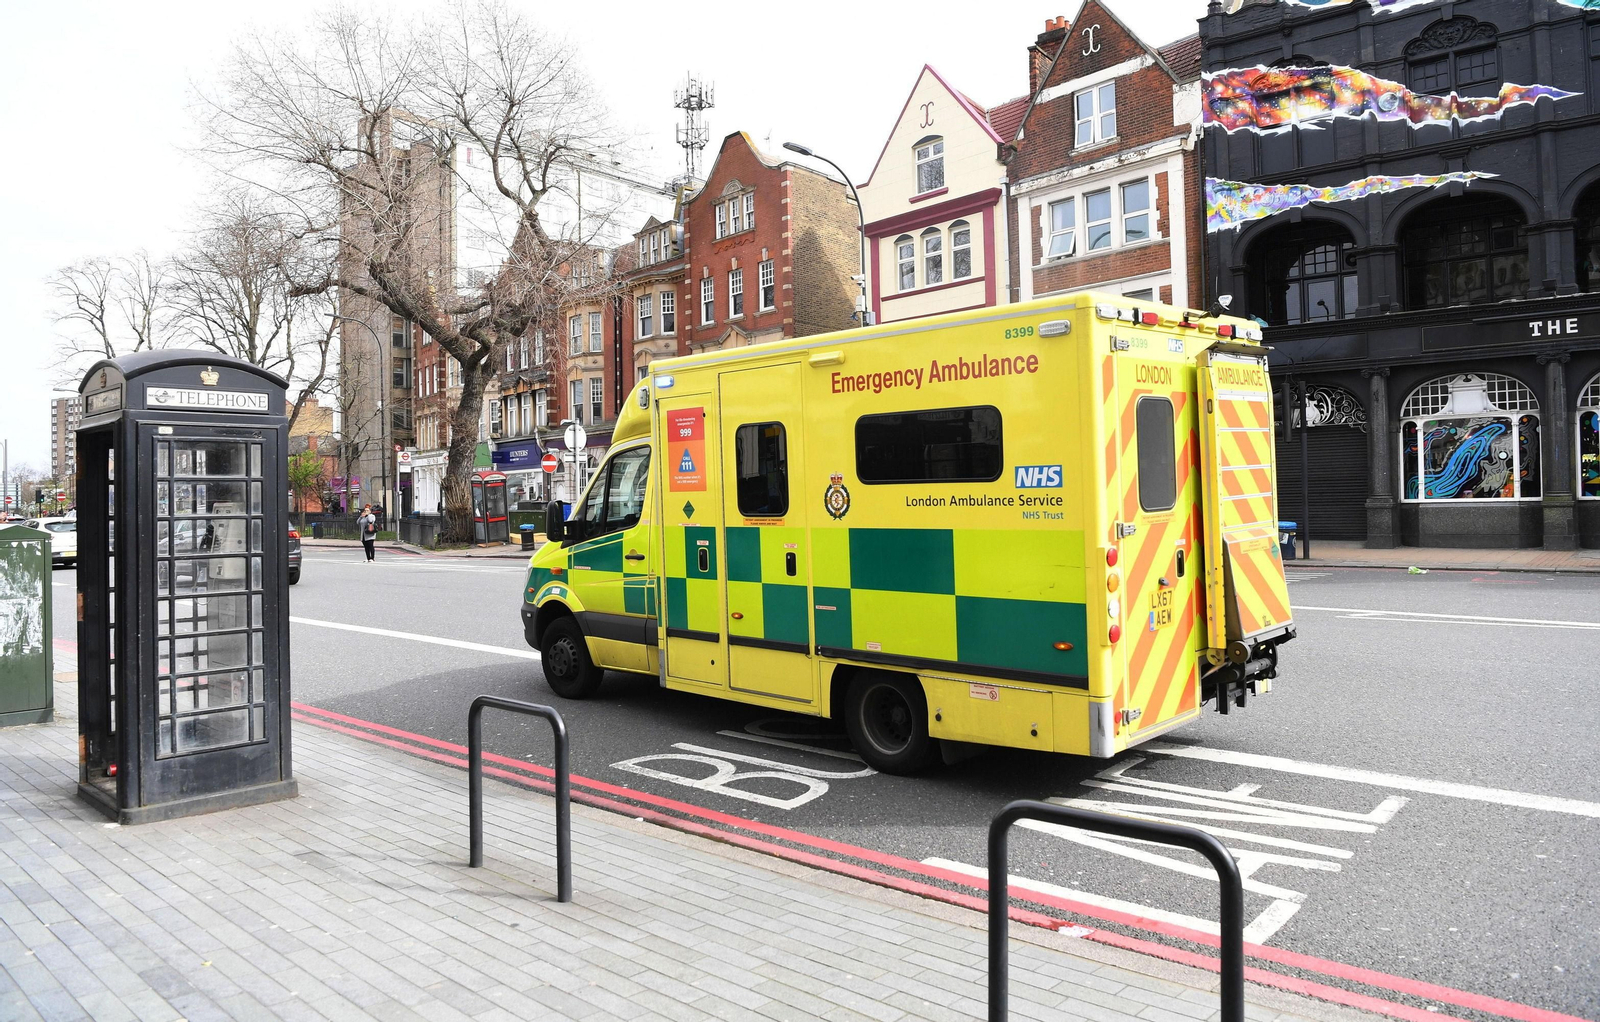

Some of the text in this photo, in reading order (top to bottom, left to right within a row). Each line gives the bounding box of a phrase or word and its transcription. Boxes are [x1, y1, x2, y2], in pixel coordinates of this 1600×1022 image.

[1004, 326, 1034, 339] 8399
[1529, 318, 1579, 337] THE
[1131, 337, 1148, 349] 8399
[1168, 339, 1183, 353] NHS
[831, 353, 1039, 394] Emergency Ambulance
[1136, 364, 1172, 386] LONDON
[1217, 366, 1264, 387] AMBULANCE
[177, 391, 267, 408] TELEPHONE
[680, 428, 691, 437] 999
[681, 461, 692, 471] 111
[1016, 466, 1060, 487] NHS
[906, 494, 1063, 507] London Ambulance Service
[1022, 511, 1064, 520] NHS Trust
[1151, 590, 1173, 608] LX67
[1156, 608, 1172, 627] AEW
